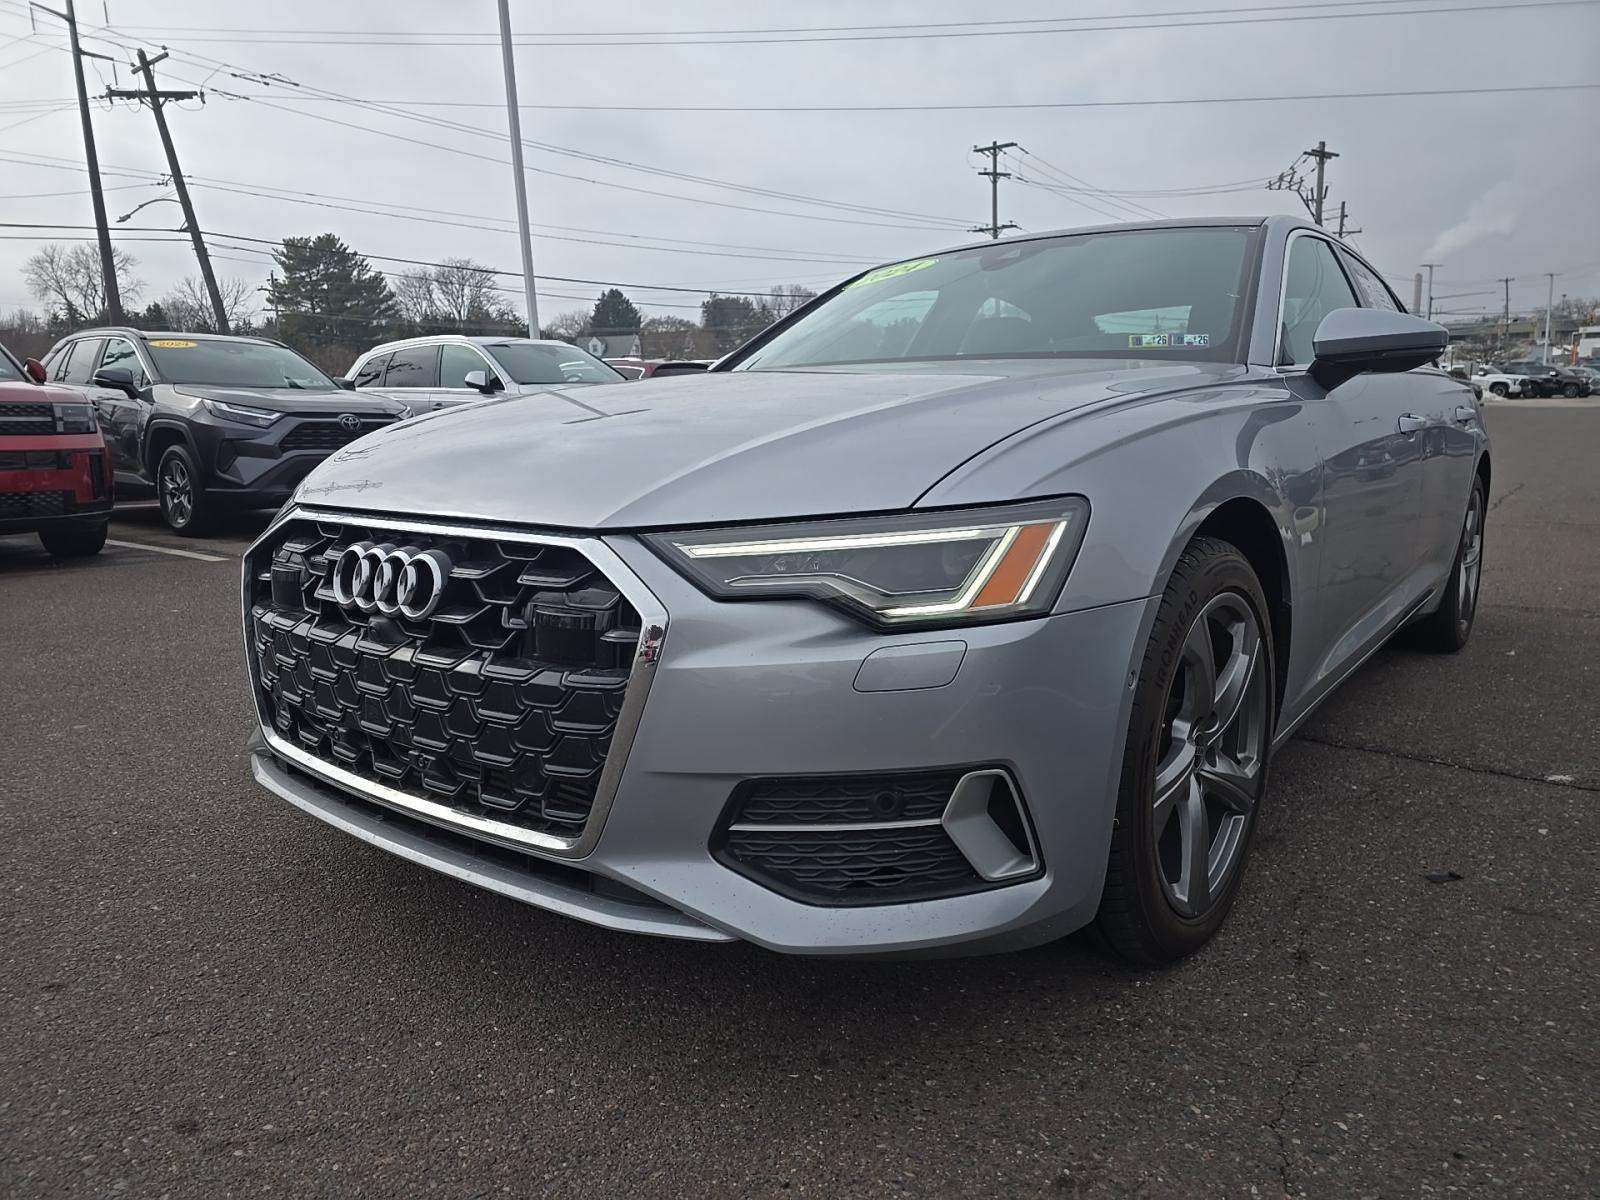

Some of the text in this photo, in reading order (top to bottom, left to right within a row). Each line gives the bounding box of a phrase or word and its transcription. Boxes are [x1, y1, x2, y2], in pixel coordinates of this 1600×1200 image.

[1157, 335, 1167, 345] 26
[1198, 335, 1208, 345] 26
[1153, 590, 1198, 689] IRONHEAD
